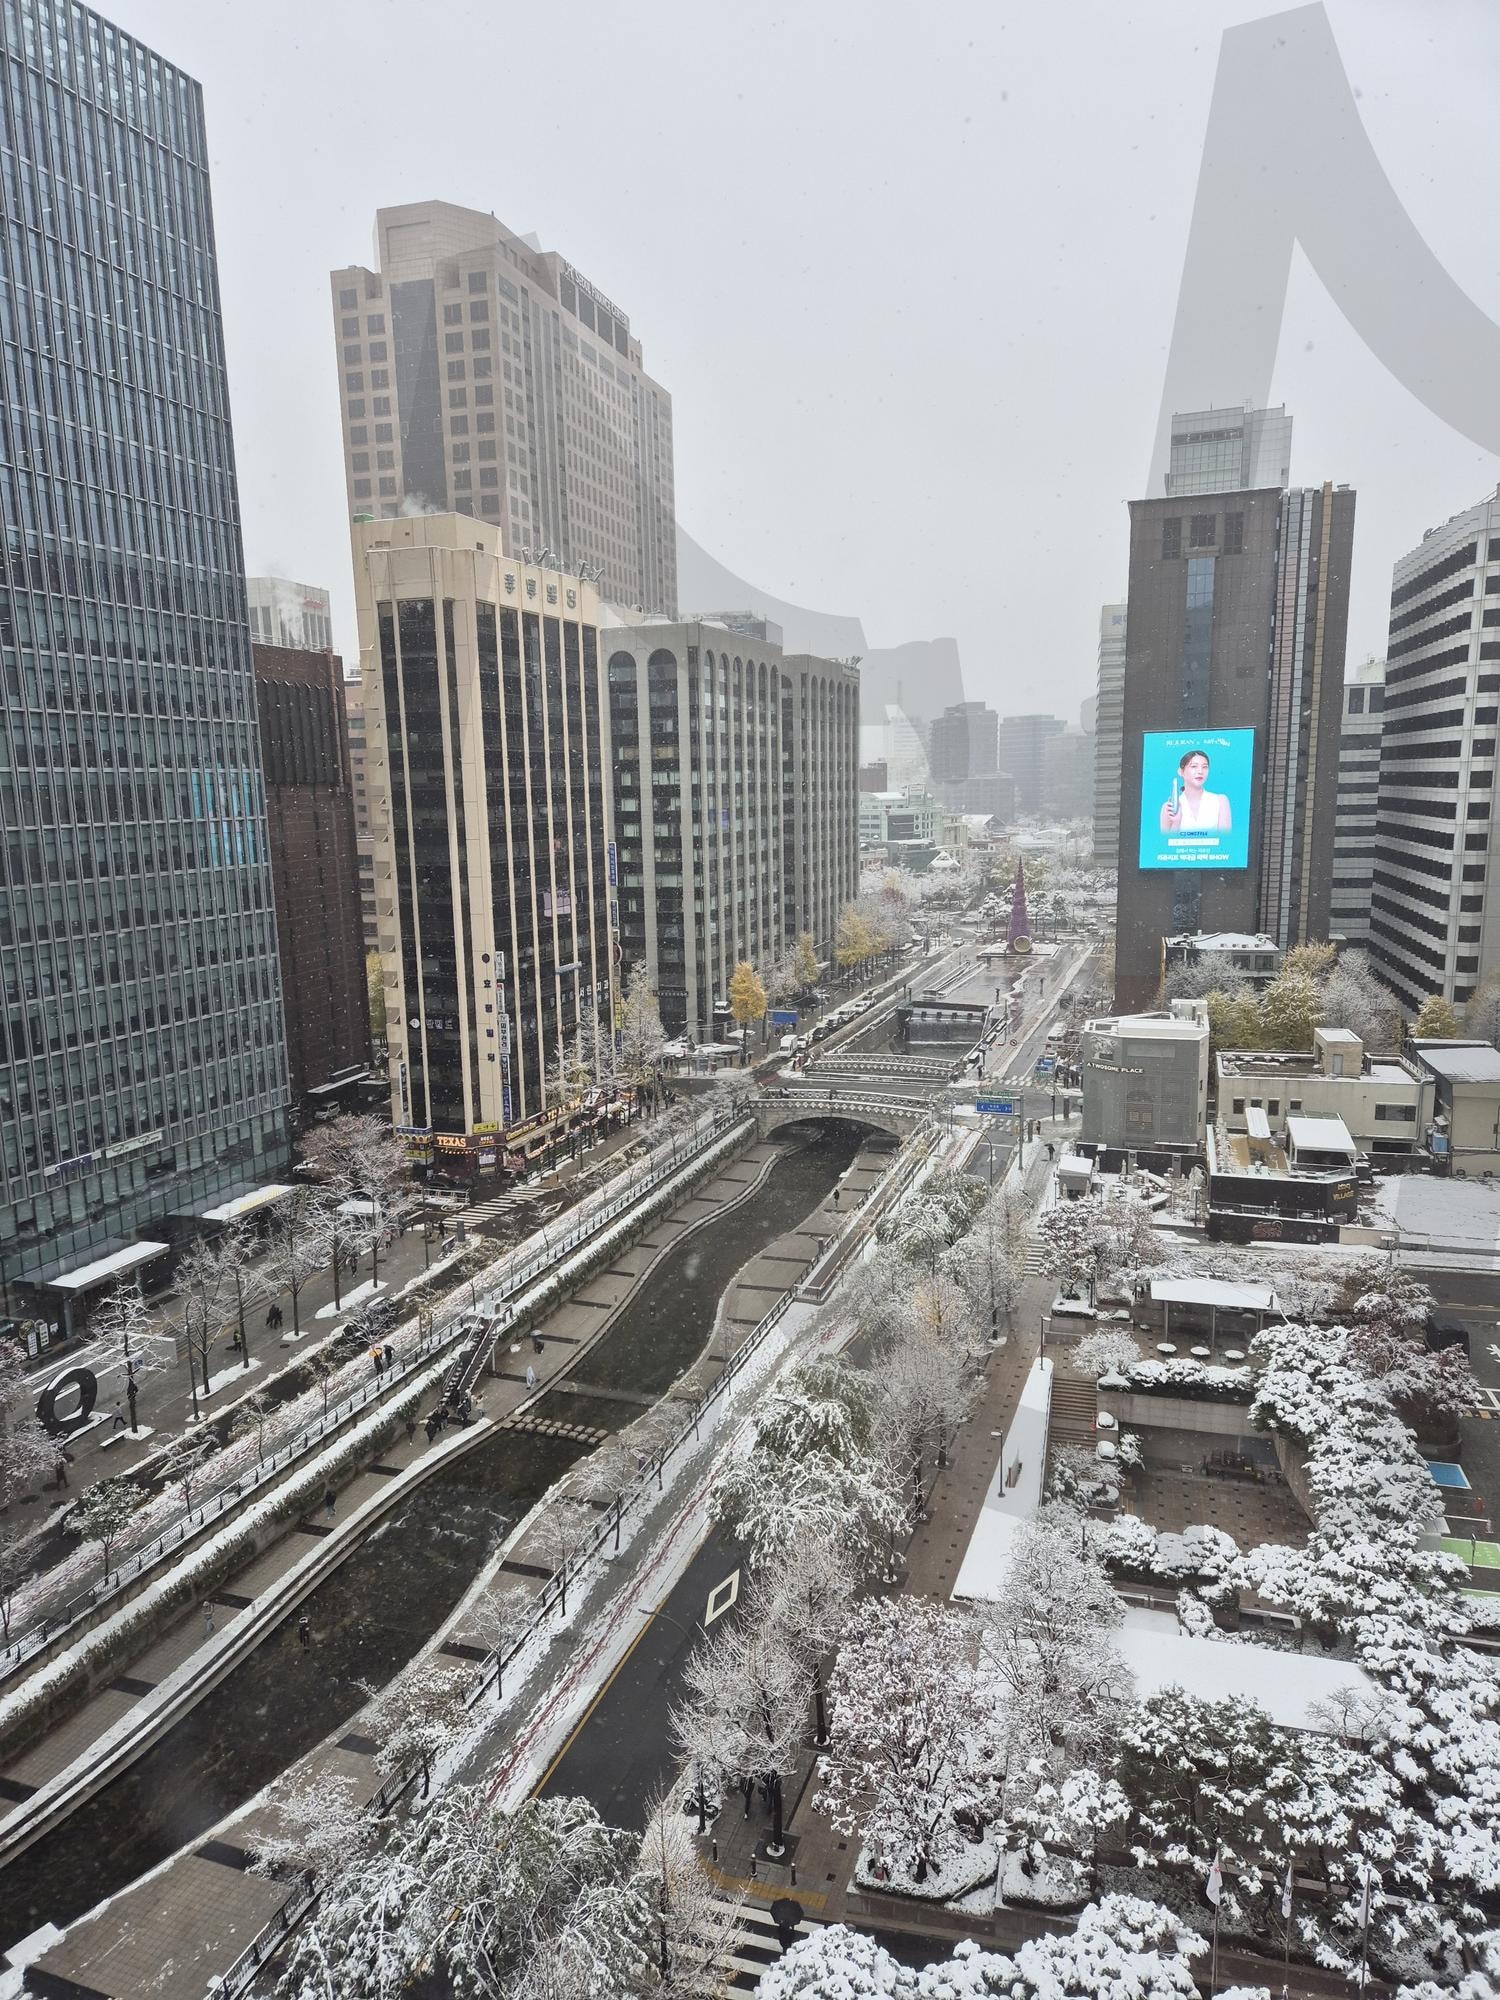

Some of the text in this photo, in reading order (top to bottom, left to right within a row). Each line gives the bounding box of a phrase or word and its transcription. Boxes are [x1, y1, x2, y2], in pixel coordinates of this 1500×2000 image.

[575, 270, 592, 294] SEOUL
[612, 301, 627, 323] CENTER
[1092, 1063, 1120, 1073] TWOSOME
[1121, 1067, 1144, 1075] PLACE
[436, 1135, 467, 1148] TEXAS
